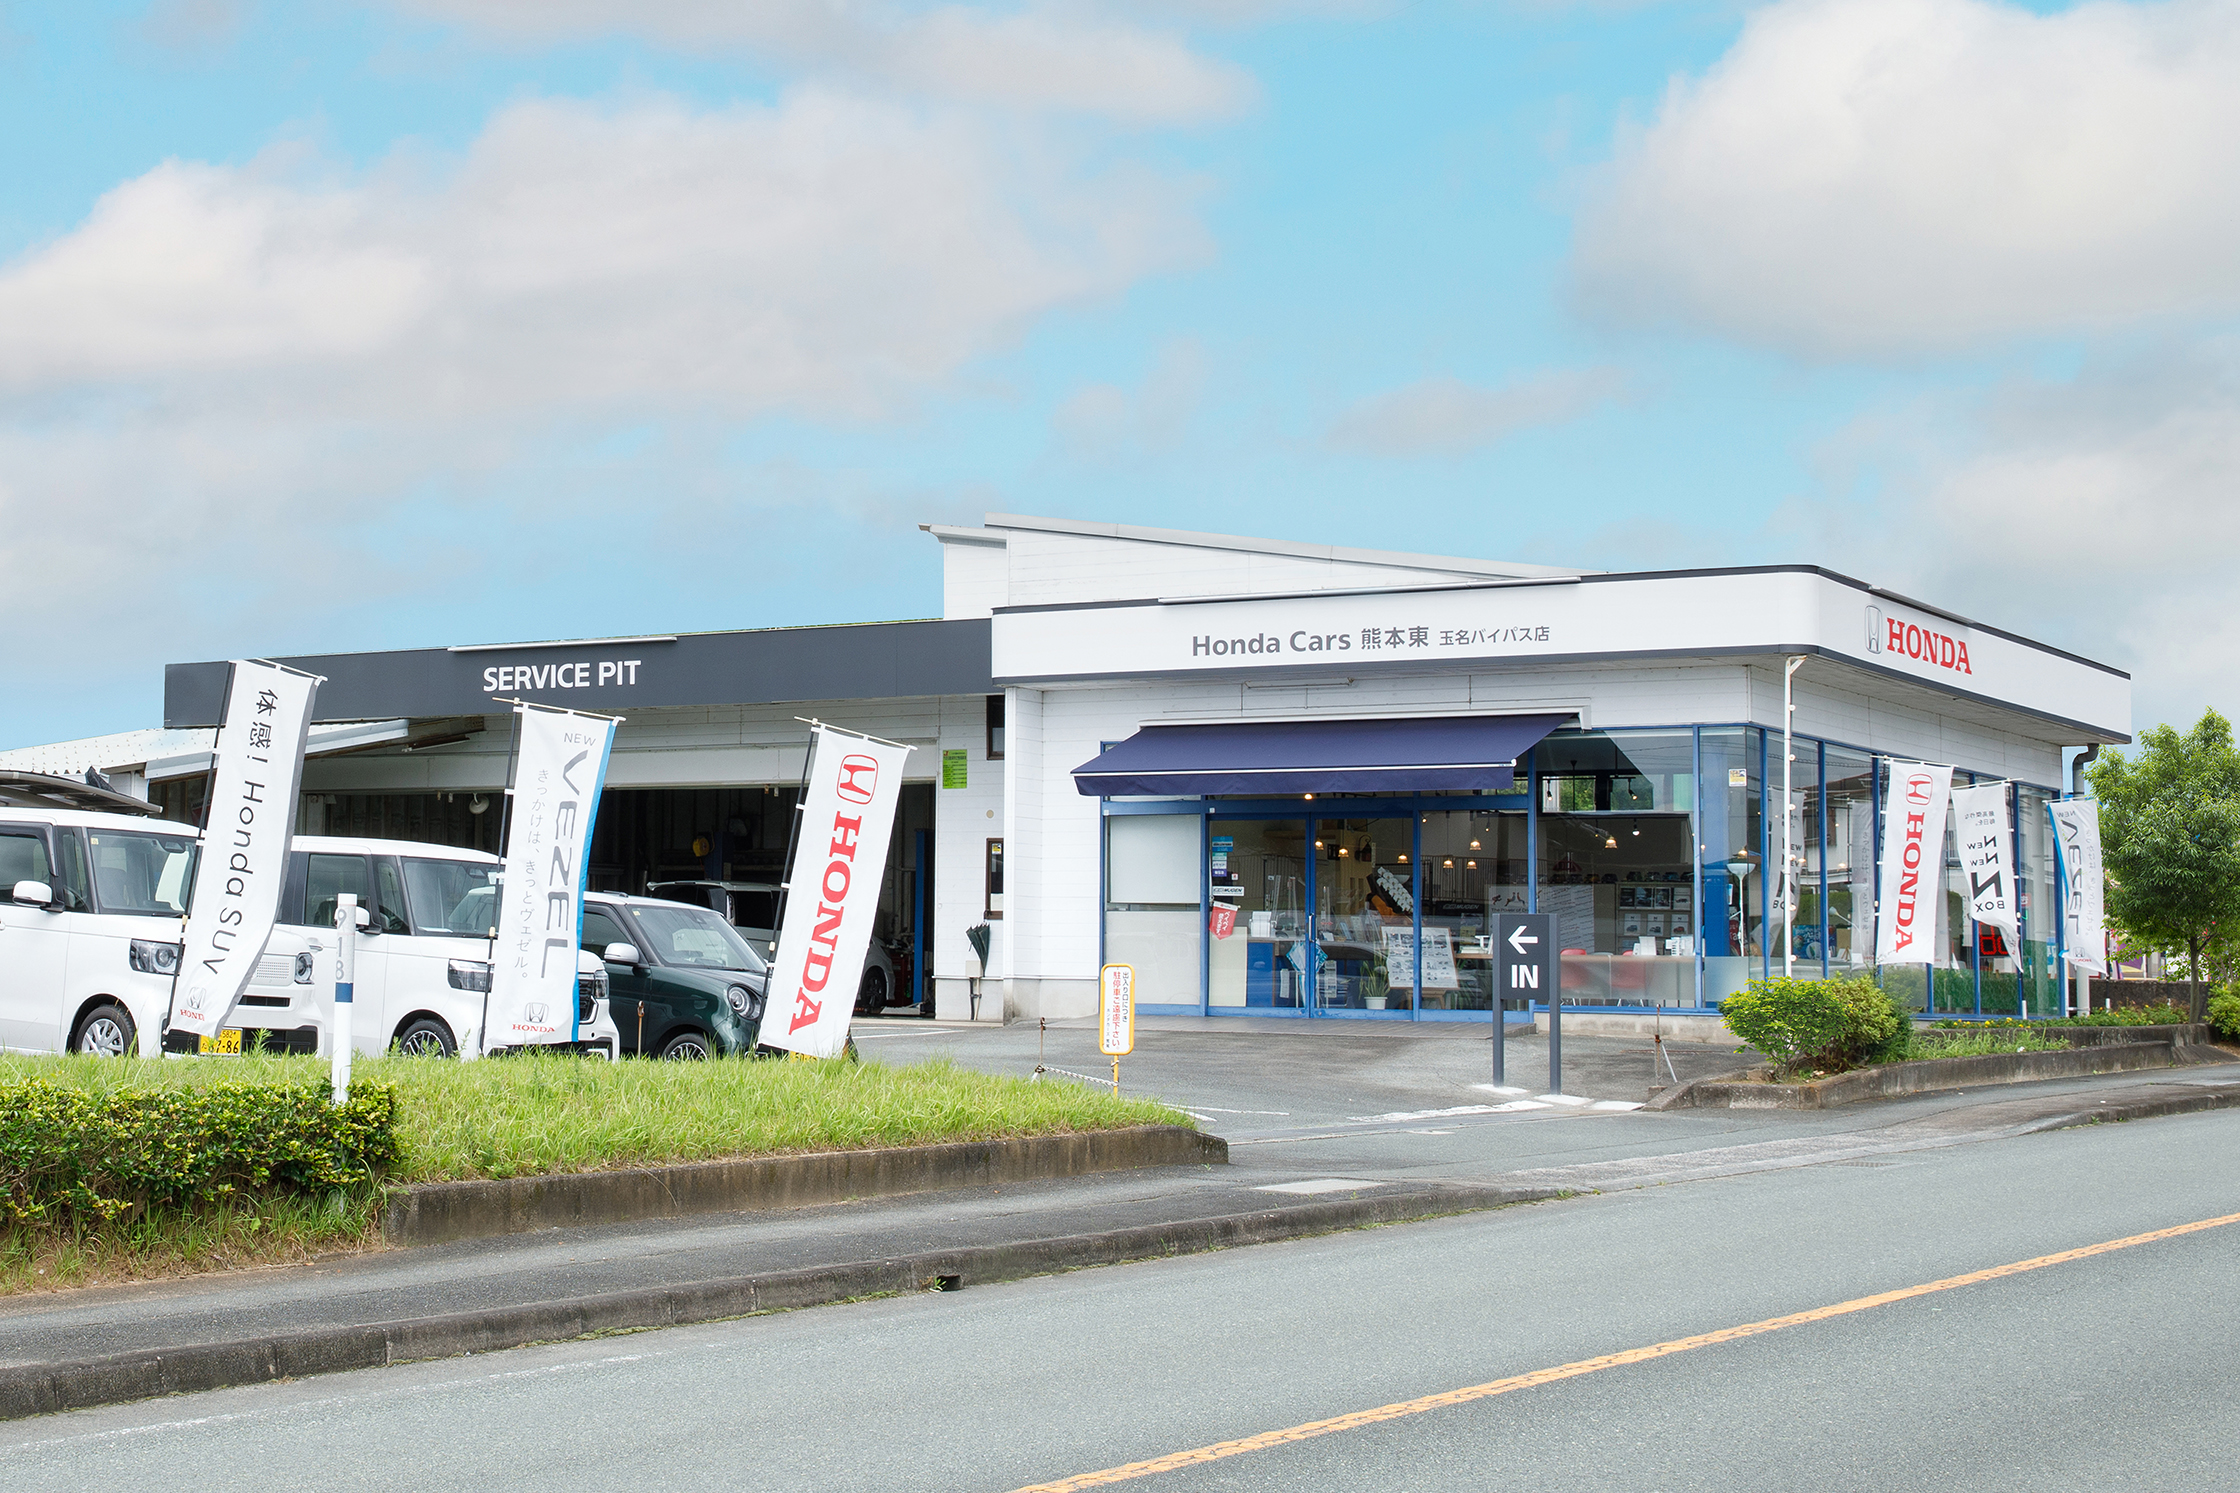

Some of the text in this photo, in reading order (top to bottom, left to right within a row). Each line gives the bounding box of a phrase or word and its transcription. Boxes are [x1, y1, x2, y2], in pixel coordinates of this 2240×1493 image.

[1192, 625, 1551, 657] Honda Cars 熊本東 玉名バイパス店
[1886, 617, 1972, 675] HONDA
[483, 659, 642, 692] SERVICE PIT
[563, 732, 597, 747] NEW
[226, 780, 265, 897] Honda
[540, 749, 589, 979] VEZEL
[1895, 811, 1925, 953] HONDA
[202, 906, 243, 975] SUV
[335, 908, 348, 981] 918
[788, 810, 863, 1036] HONDA
[1122, 971, 1130, 1023] 出入り口につき
[1511, 964, 1539, 989] IN
[511, 1023, 556, 1033] HONDA
